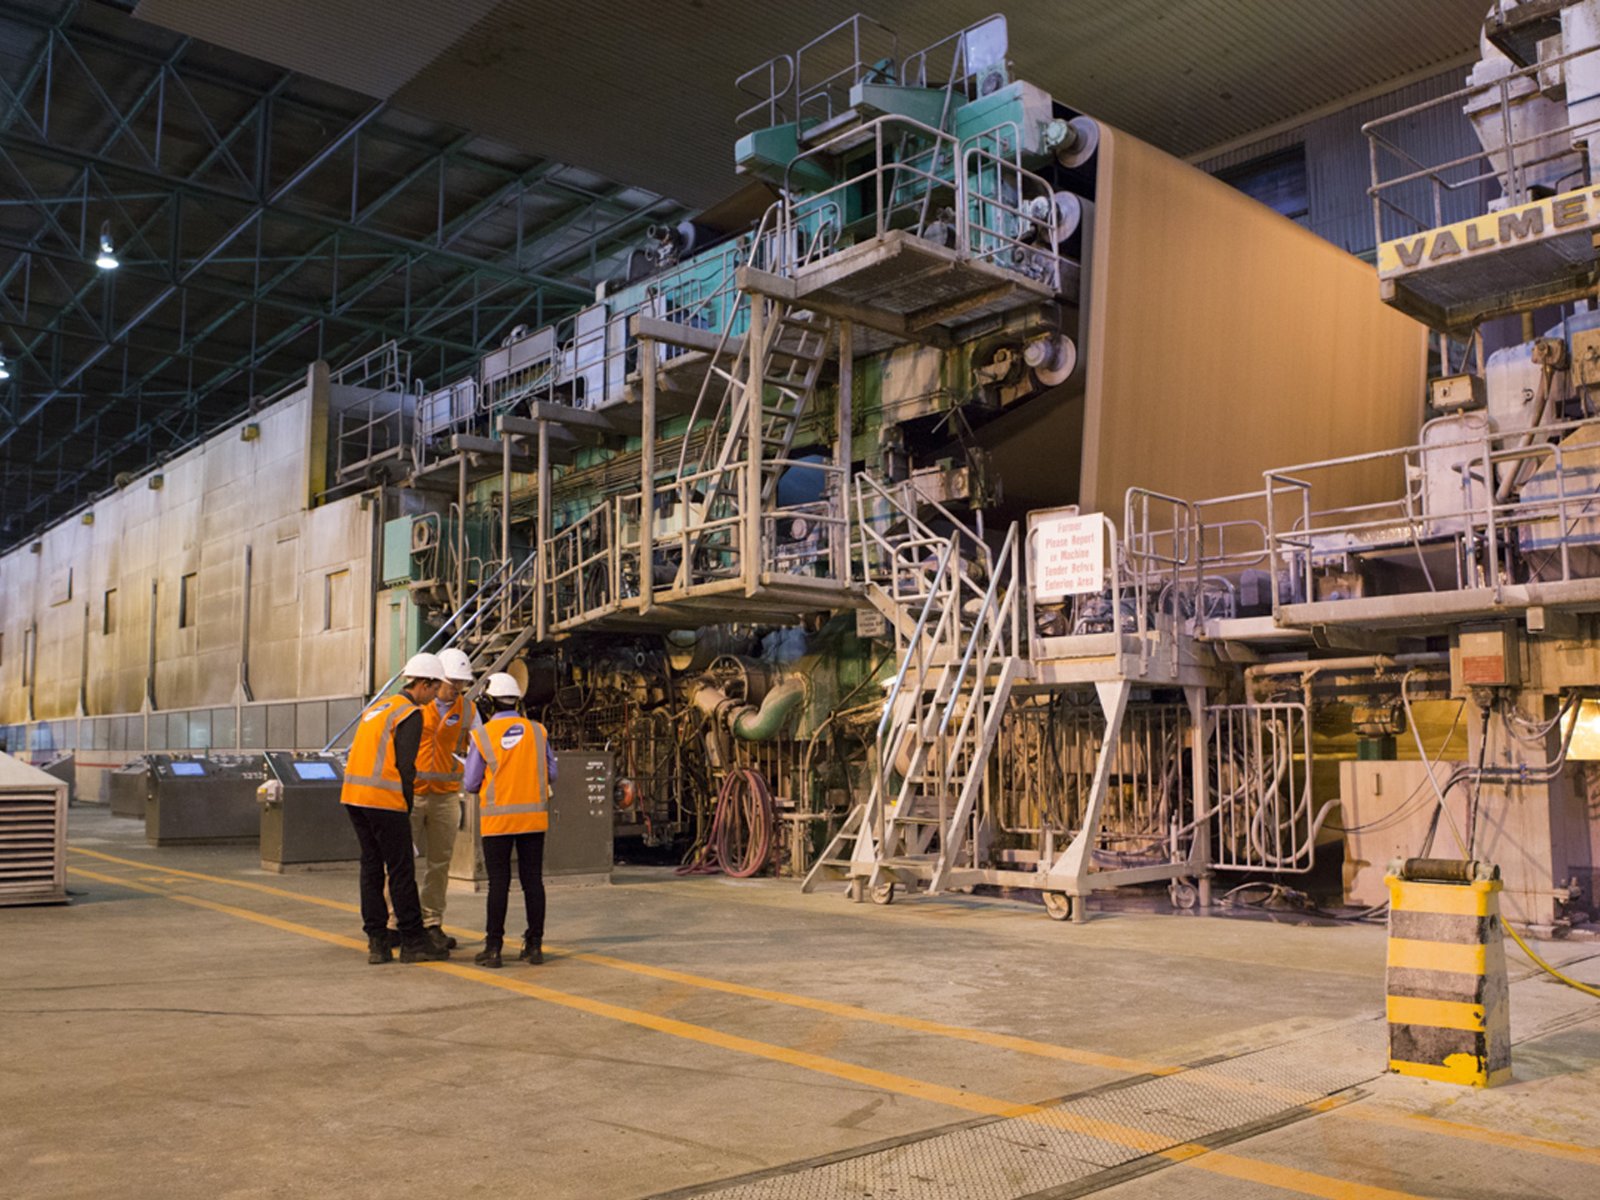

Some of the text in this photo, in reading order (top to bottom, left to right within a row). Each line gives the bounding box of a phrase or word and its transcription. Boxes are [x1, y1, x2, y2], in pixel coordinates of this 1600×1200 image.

[1395, 191, 1600, 267] VALME
[1045, 533, 1094, 549] Please Report
[1060, 549, 1089, 561] Machine
[1071, 562, 1094, 574] Before
[1045, 576, 1094, 591] Entering Area
